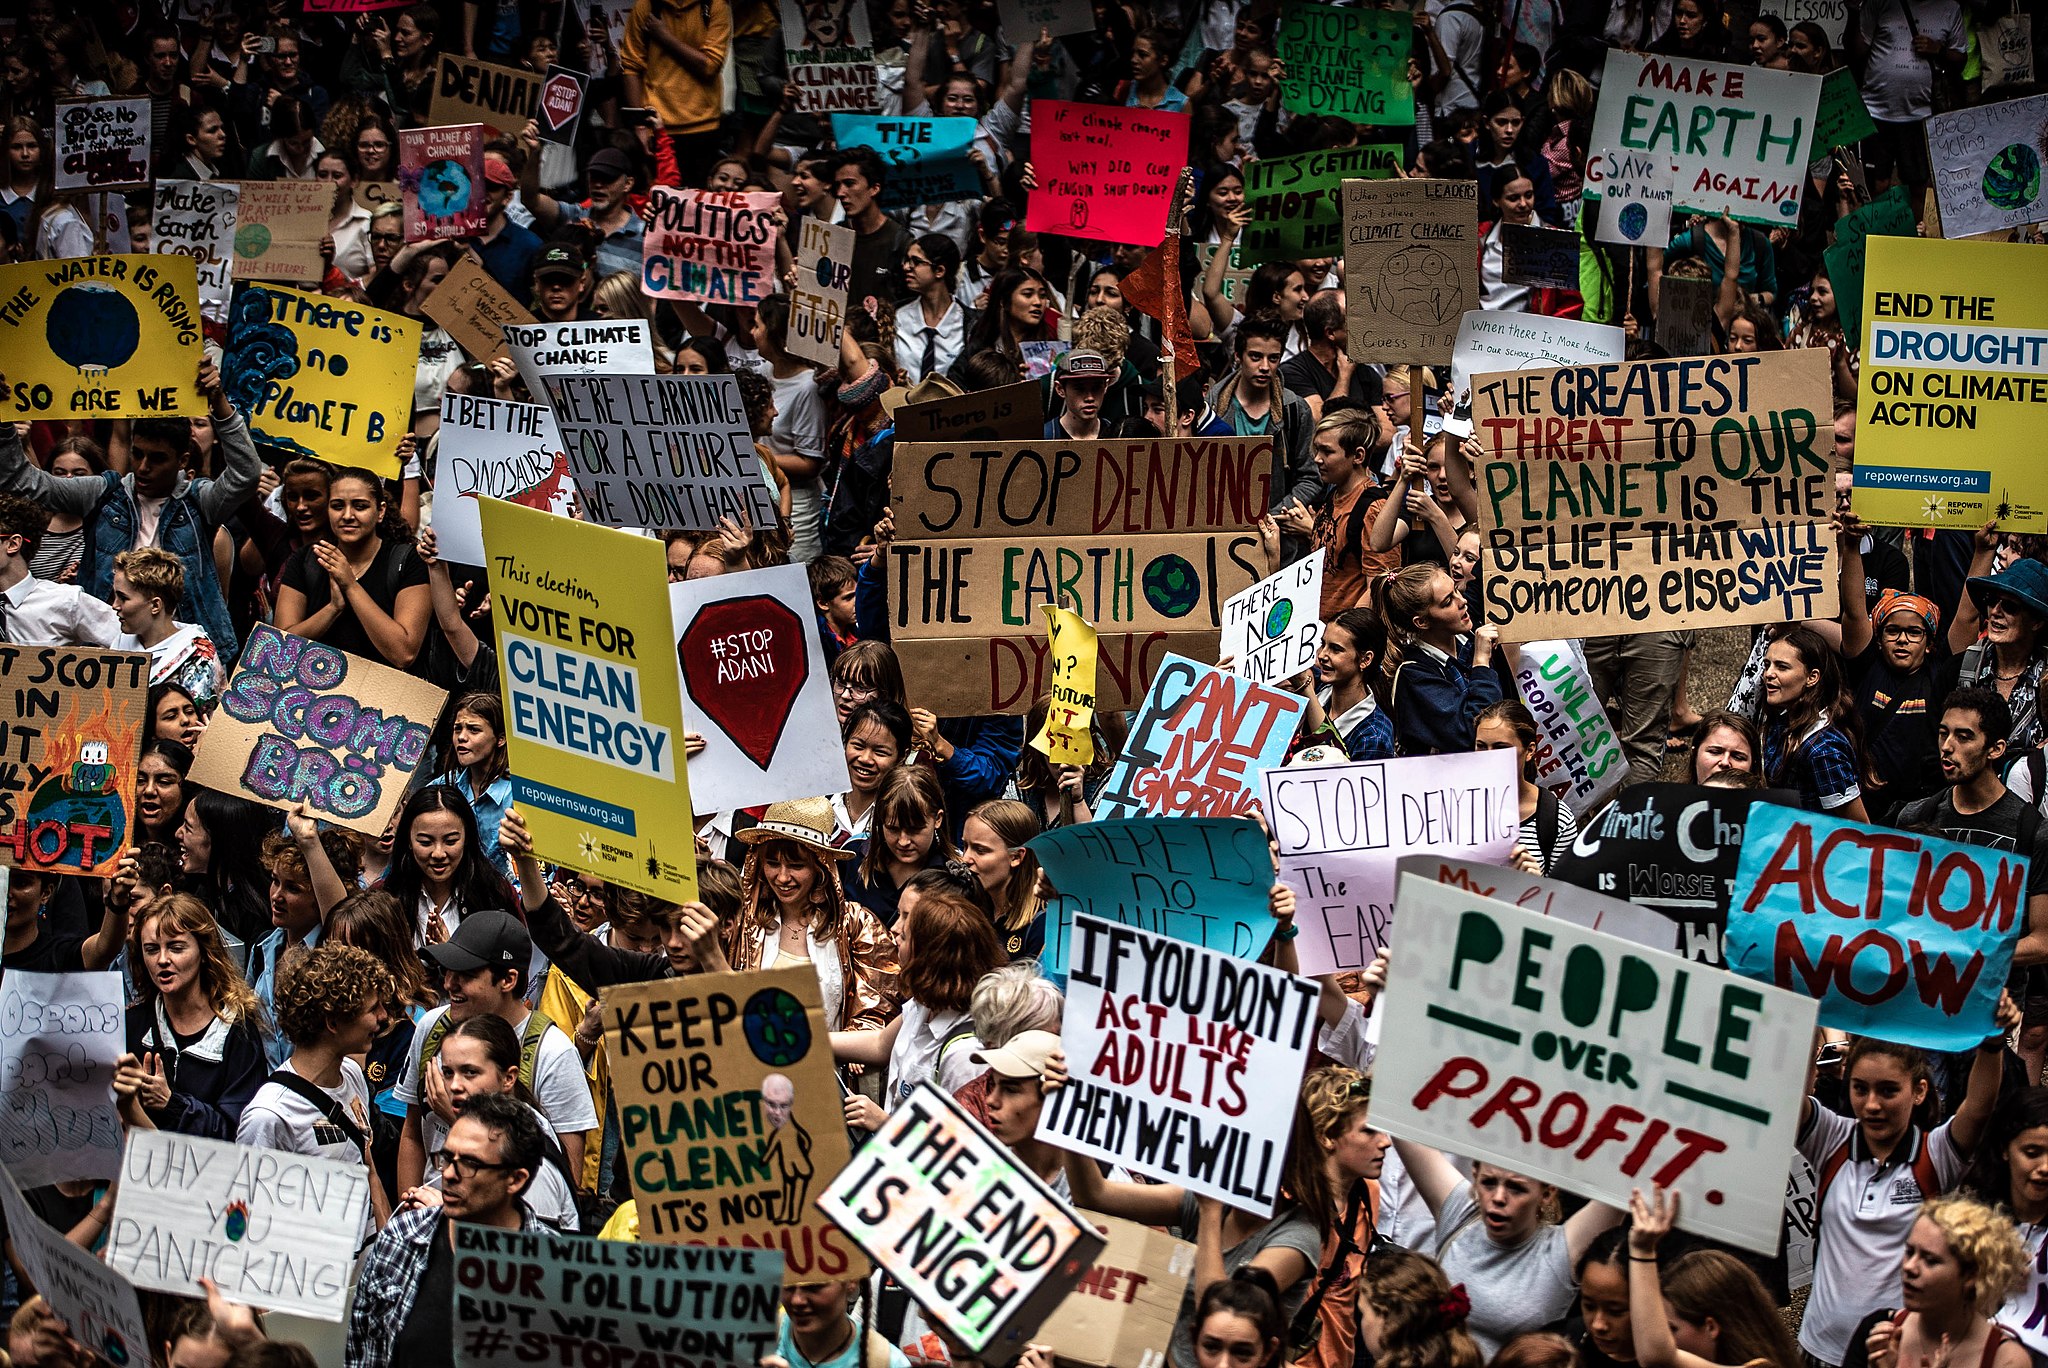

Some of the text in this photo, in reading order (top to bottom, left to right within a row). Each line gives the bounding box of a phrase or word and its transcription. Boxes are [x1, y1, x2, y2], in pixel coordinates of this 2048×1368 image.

[1287, 9, 1359, 41] STOP
[793, 64, 877, 86] CLIMATE
[1310, 67, 1365, 88] PLANET
[1637, 58, 1744, 98] MAKE
[116, 106, 137, 123] No
[549, 99, 573, 113] ADANI
[799, 87, 880, 110] CHANGE
[406, 134, 425, 145] OUR
[430, 131, 461, 143] PLANET
[876, 122, 932, 144] THE
[1131, 122, 1171, 142] change
[1620, 95, 1802, 165] EARTH
[1068, 160, 1098, 175] WHY
[1108, 160, 1132, 174] DID
[156, 186, 215, 213] Make
[1103, 182, 1128, 196] SHUT
[1253, 190, 1326, 221] HOT
[1349, 183, 1476, 205] When your LEADERS
[1608, 182, 1631, 198] OUR
[414, 221, 428, 235] SO
[466, 217, 488, 230] WE
[1349, 223, 1465, 242] CLIMATE CHANGE
[1380, 207, 1414, 220] believe
[713, 239, 763, 270] THE
[1252, 228, 1280, 250] IN
[645, 255, 760, 303] CLIMATE
[45, 257, 198, 347] WATER IS RISING
[1874, 291, 1996, 321] END THE
[502, 325, 641, 347] STOP CLIMATE
[1471, 320, 1504, 335] When
[1875, 328, 2047, 367] DROUGHT
[534, 349, 608, 366] CHANGE
[15, 382, 179, 412] SO ARE WE
[622, 376, 743, 426] LEARNING
[1478, 374, 1545, 417] THE
[1550, 356, 1762, 418] GREATEST
[1870, 371, 2047, 404] ON CLIMATE
[367, 412, 385, 443] B
[459, 398, 550, 438] BET THE
[919, 402, 1012, 431] There is
[1869, 402, 1977, 430] ACTION
[562, 428, 759, 478] FOR A FUTURE
[1481, 408, 1829, 480] THREAT TO OUR
[919, 441, 1273, 534] STOP DENYING
[1485, 461, 1828, 530] PLANET IS THE
[1865, 470, 1979, 488] repowernsw.org.au
[628, 482, 701, 529] DON'T
[1947, 508, 1964, 516] NSW
[1948, 501, 1983, 509] REPOWER
[1488, 519, 1828, 574] BELIEF THAT WILL
[891, 545, 1133, 628] THE EARTH
[1227, 574, 1282, 626] THERE
[1738, 555, 1824, 605] SAVE
[1784, 586, 1824, 622] IT
[500, 594, 637, 660] VOTE FOR
[28, 648, 147, 690] SCOTT
[240, 622, 349, 692] NO
[507, 640, 635, 714] CLEAN
[717, 652, 776, 685] ADANI
[15, 687, 60, 718] IN
[1516, 669, 1570, 741] PEOPLE
[1540, 653, 1620, 779] UNLESS
[513, 690, 666, 774] ENERGY
[1277, 776, 1381, 851] STOP
[601, 843, 634, 860] REPOWER
[602, 852, 618, 863] NSW
[1598, 863, 1717, 898] IS WORSE
[1742, 820, 2025, 932] ACTION
[1071, 915, 1131, 993] IF
[1138, 933, 1203, 1015] YOU
[1212, 956, 1319, 1050] DON'T
[1773, 919, 1988, 1016] NOW
[1449, 910, 1764, 1081] PEOPLE
[616, 990, 738, 1056] KEEP
[1095, 990, 1255, 1066] ACT LIKE
[642, 1053, 718, 1095] OUR
[1090, 1030, 1248, 1117] ADULTS
[1531, 1030, 1639, 1090] OVER
[623, 1088, 765, 1148] PLANET
[1046, 1078, 1274, 1207] THEN WE WILL
[128, 1132, 365, 1222] WHY AREN'T
[634, 1140, 773, 1194] CLEAN
[889, 1100, 1059, 1273] THE END
[719, 1190, 781, 1226] NOT
[457, 1226, 540, 1258] EARTH
[549, 1237, 616, 1267] WILL
[625, 1243, 755, 1275] SURVIVE
[838, 1156, 909, 1227] IS
[894, 1206, 1019, 1332] NIGH
[457, 1255, 781, 1324] OUR POLLUTION
[458, 1294, 621, 1344] BUT WE
